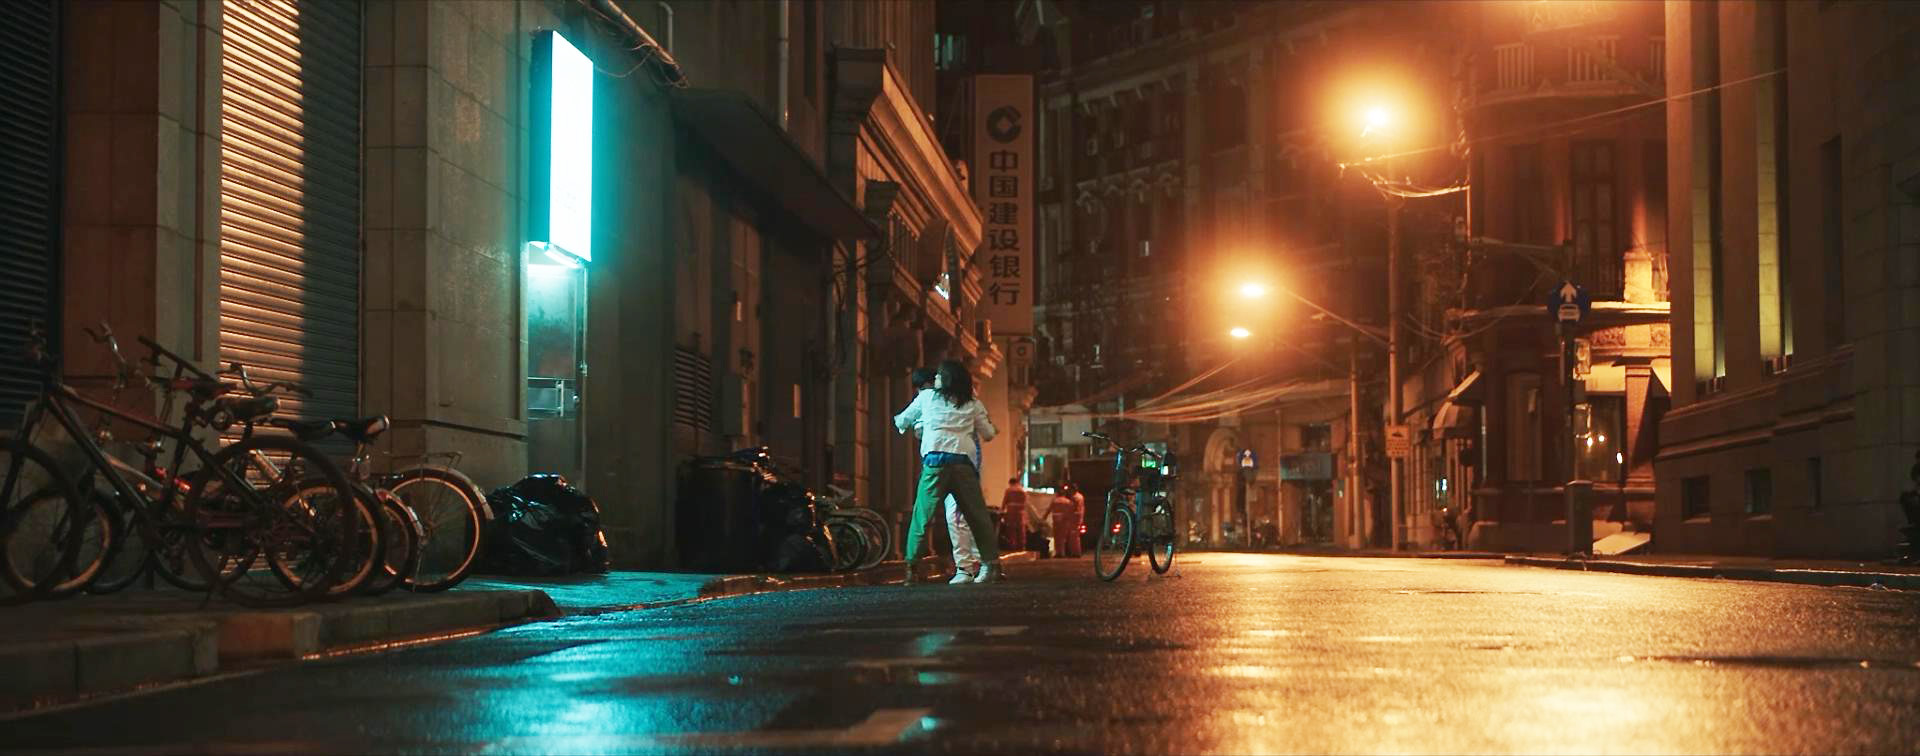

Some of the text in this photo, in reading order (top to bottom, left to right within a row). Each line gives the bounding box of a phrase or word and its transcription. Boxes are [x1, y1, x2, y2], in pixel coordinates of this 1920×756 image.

[988, 150, 1020, 305] 中国建设银行
